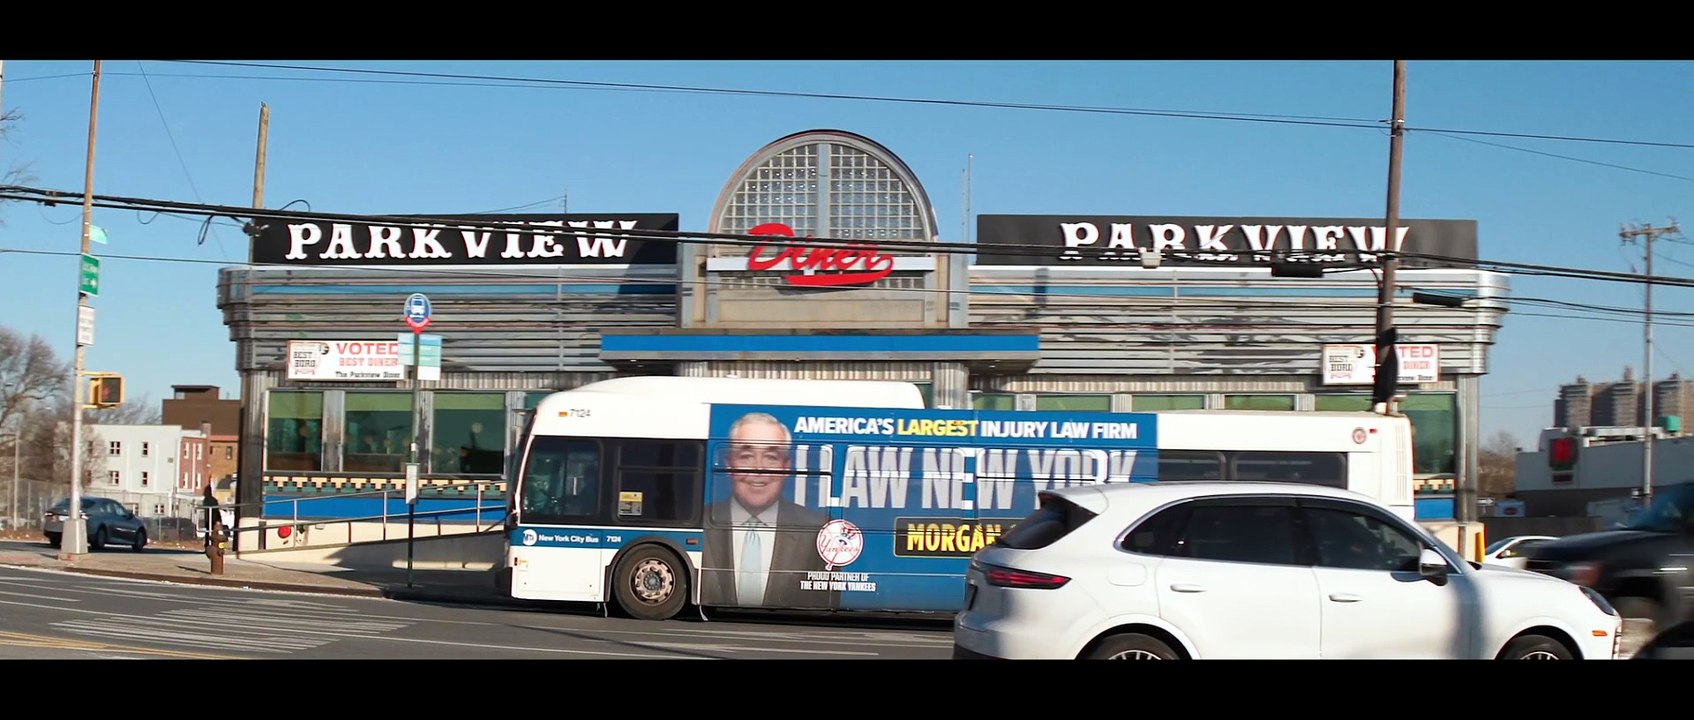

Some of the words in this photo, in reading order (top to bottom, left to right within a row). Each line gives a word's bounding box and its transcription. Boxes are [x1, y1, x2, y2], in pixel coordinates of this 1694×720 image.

[285, 219, 637, 260] PARKVIEW
[1059, 222, 1410, 262] PARKVIEW
[747, 222, 895, 286] Diner
[339, 357, 364, 366] BEST
[569, 409, 591, 417] 7124
[794, 417, 894, 435] AMERICA'S
[898, 419, 978, 438] LARGEST
[981, 422, 1048, 439] INJURY
[1050, 425, 1092, 440] LAW
[1093, 426, 1137, 440] FIRM
[818, 444, 914, 508] LAW
[922, 447, 1018, 510] NEW
[538, 534, 554, 542] New
[570, 535, 585, 544] City
[585, 535, 599, 543] Bus
[831, 572, 860, 581] PARTNER
[800, 580, 813, 590] THE
[813, 580, 828, 590] NEW
[829, 581, 847, 591] YORK
[847, 582, 876, 592] YANKEES
